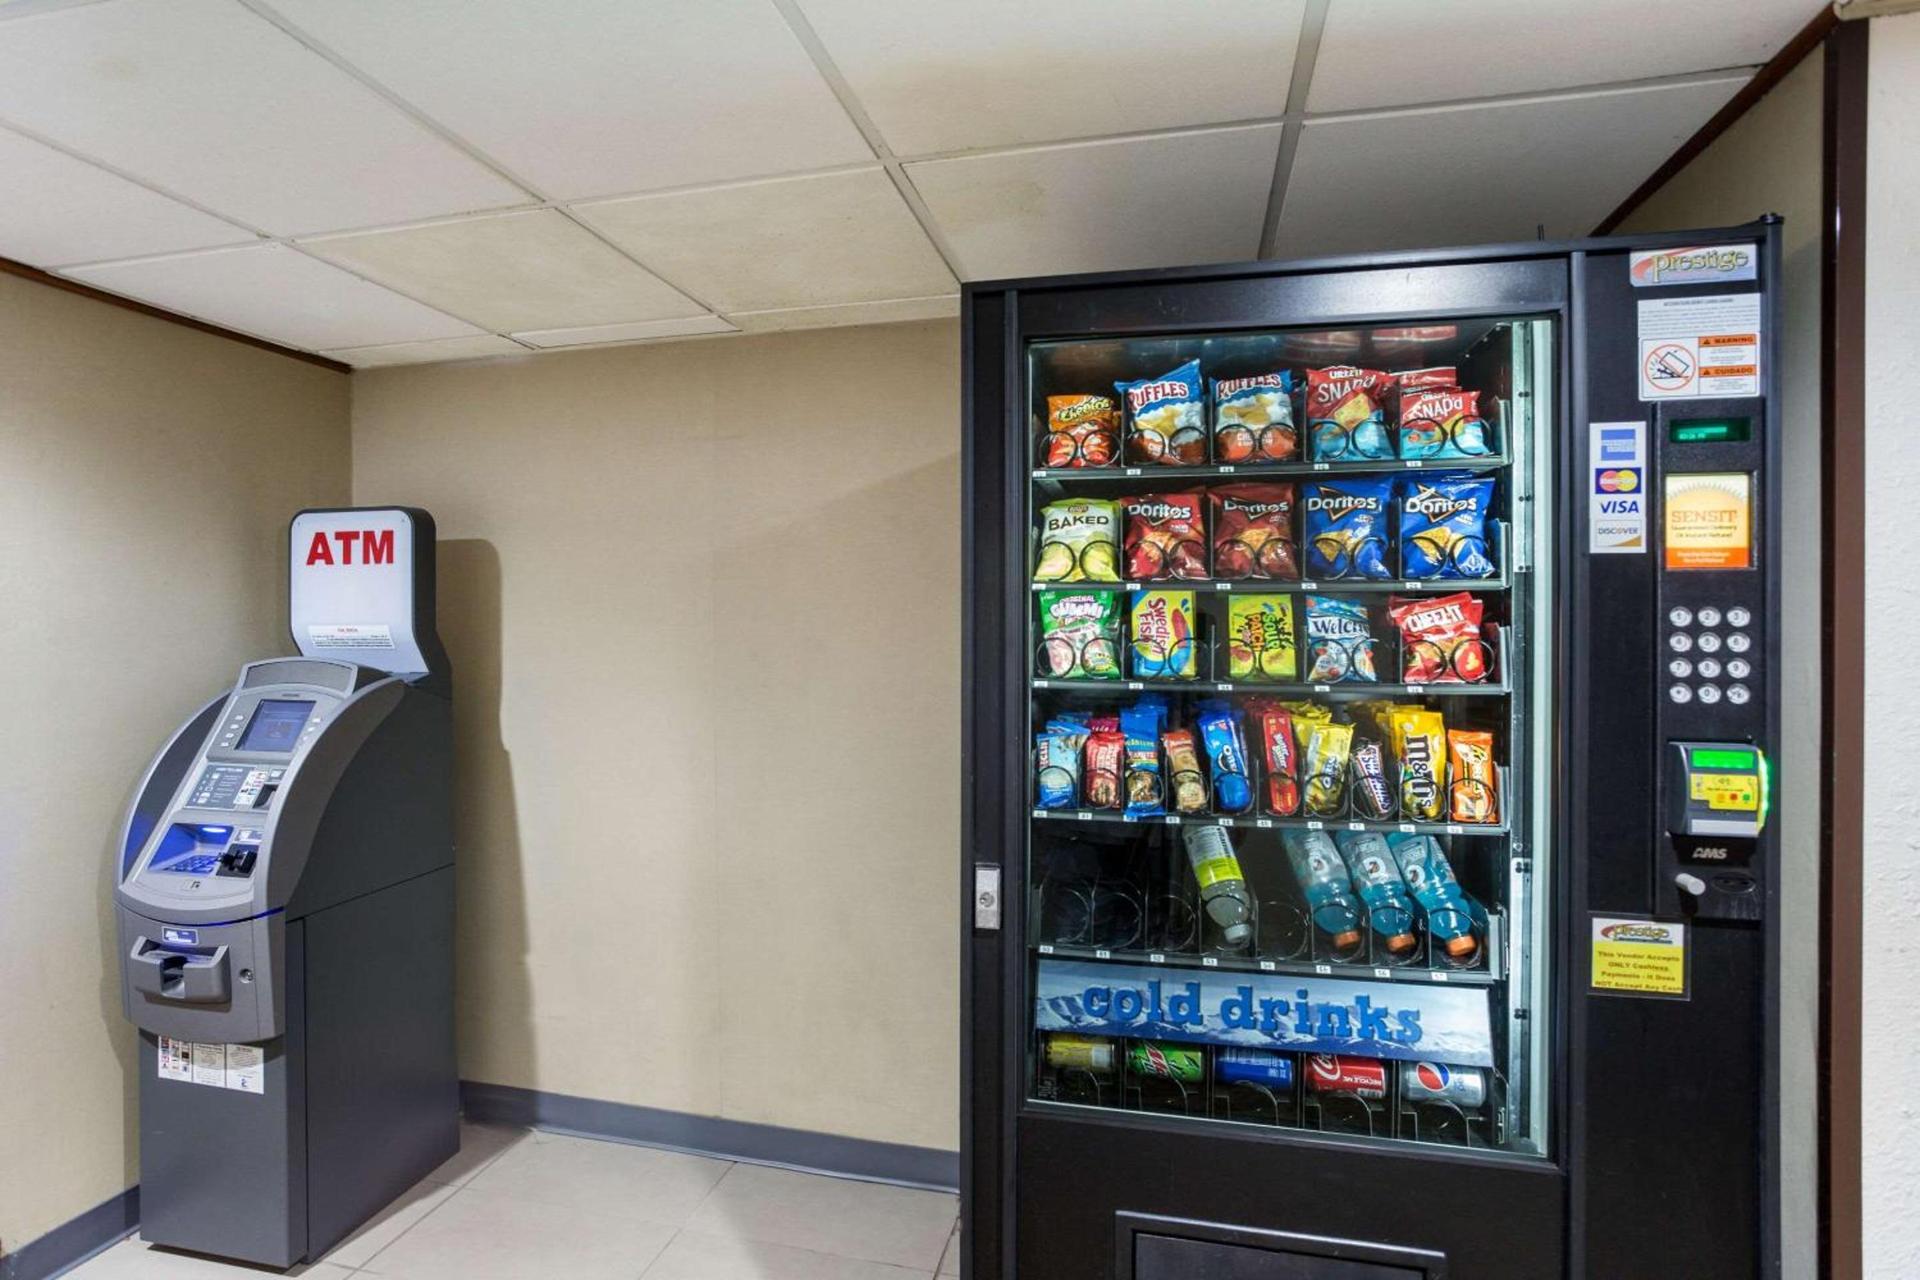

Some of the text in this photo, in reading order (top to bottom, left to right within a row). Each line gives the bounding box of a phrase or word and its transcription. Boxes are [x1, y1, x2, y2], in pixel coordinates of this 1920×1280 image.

[1714, 336, 1753, 344] WARNING
[1714, 367, 1753, 375] CUIDADO
[1128, 383, 1187, 411] RUFFLES
[1224, 500, 1289, 513] Doritos
[1307, 496, 1377, 511] Doritos
[1405, 497, 1477, 513] Doritos
[1600, 500, 1639, 514] VISA
[1128, 504, 1191, 519] Doritos
[1048, 515, 1109, 531] BAKED
[1598, 527, 1638, 535] DISCOVER
[306, 530, 394, 565] ATM
[1251, 613, 1265, 652] PATCH
[1265, 613, 1279, 651] SOUR
[1692, 847, 1728, 859] AMS
[1648, 954, 1680, 962] Accepts
[1632, 963, 1668, 972] Cashless
[1601, 971, 1641, 979] Payments
[1083, 979, 1424, 1044] cold drinks
